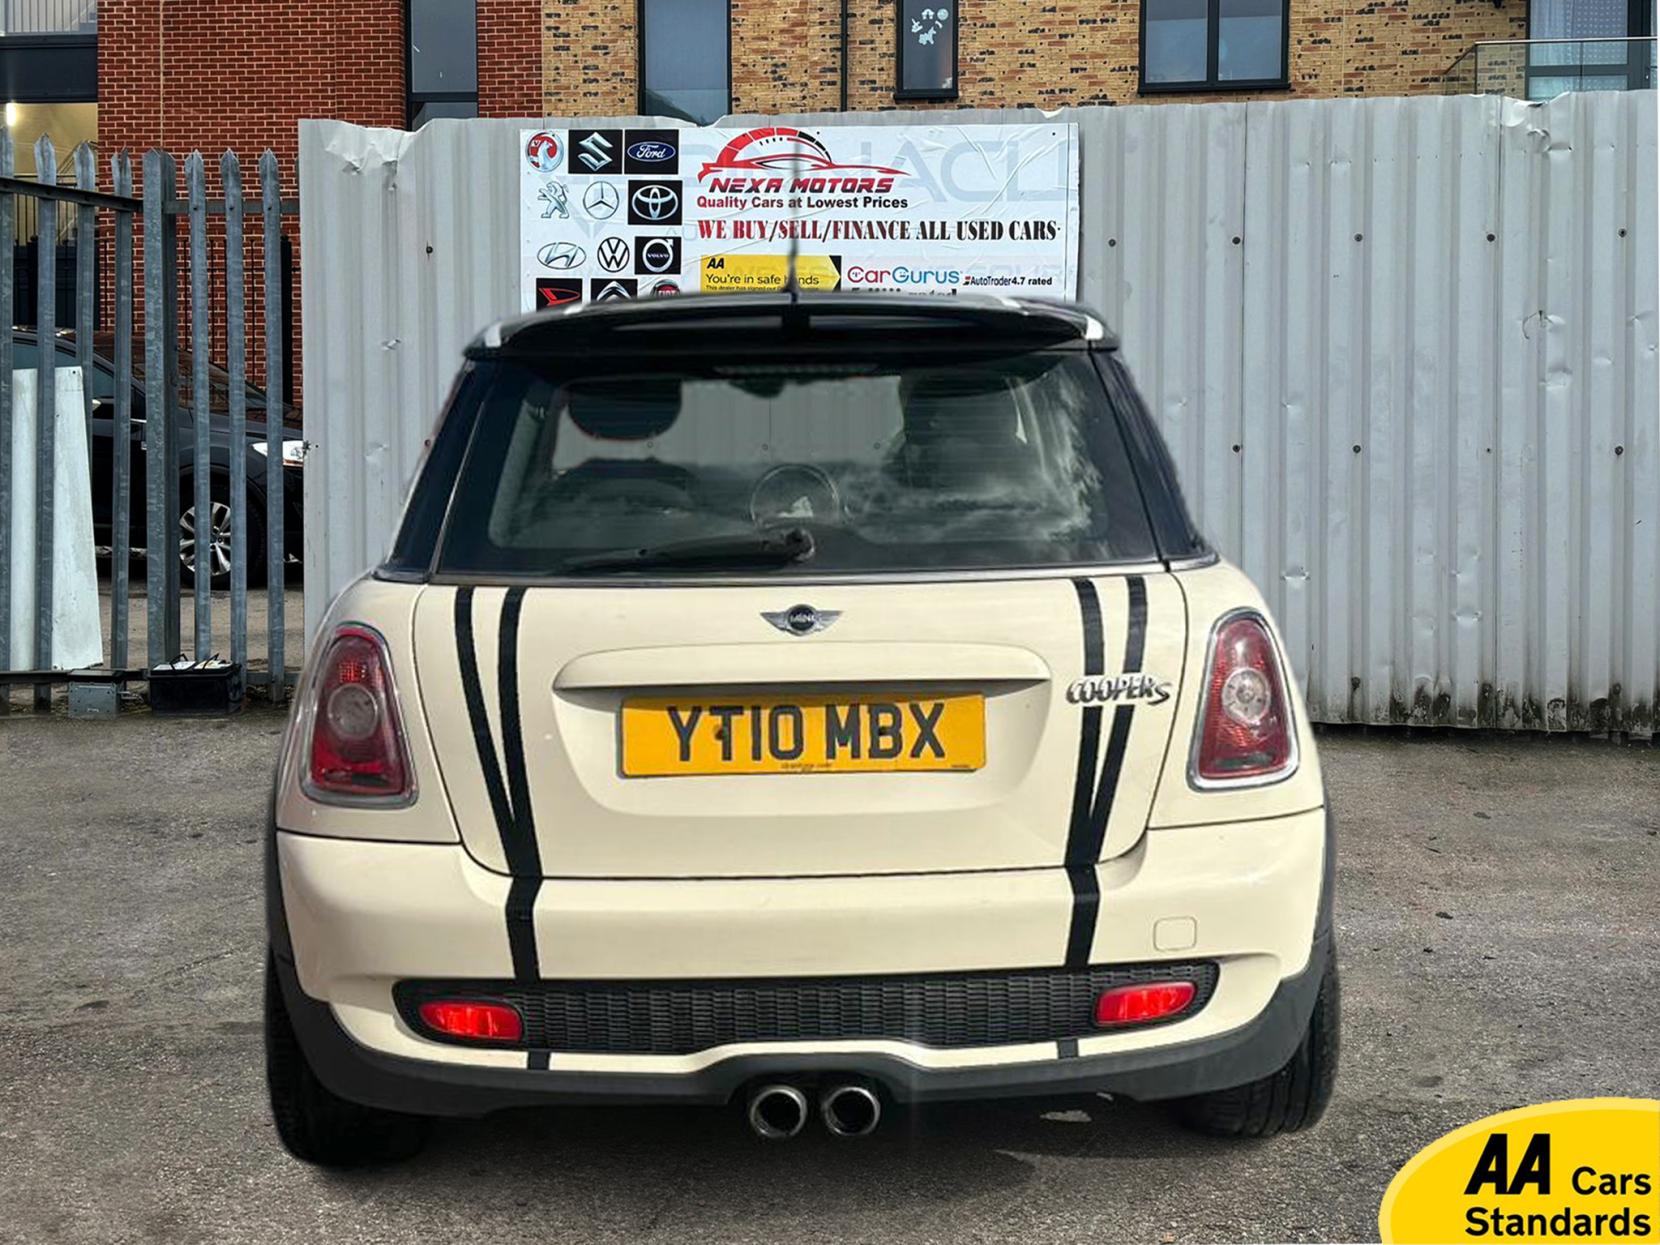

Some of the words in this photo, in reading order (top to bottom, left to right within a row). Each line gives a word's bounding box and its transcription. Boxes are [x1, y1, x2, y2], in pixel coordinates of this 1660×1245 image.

[636, 143, 666, 159] Ford
[708, 177, 784, 194] NEXA
[789, 177, 894, 194] MOTORS
[696, 195, 748, 210] Quality
[752, 196, 784, 208] Cars
[788, 196, 802, 208] at
[807, 196, 859, 208] Lowest
[863, 196, 908, 209] Prices
[697, 219, 727, 240] WE
[916, 220, 951, 241] ALL
[956, 220, 1004, 241] USED
[1008, 220, 1057, 241] CARS
[706, 257, 725, 269] AA
[705, 273, 741, 284] You're
[744, 273, 754, 284] in
[757, 274, 781, 285] safe
[784, 275, 820, 286] nds
[847, 265, 960, 284] CarGurus
[1027, 276, 1053, 286] rated
[667, 704, 804, 761] YT10
[825, 702, 946, 760] MBX
